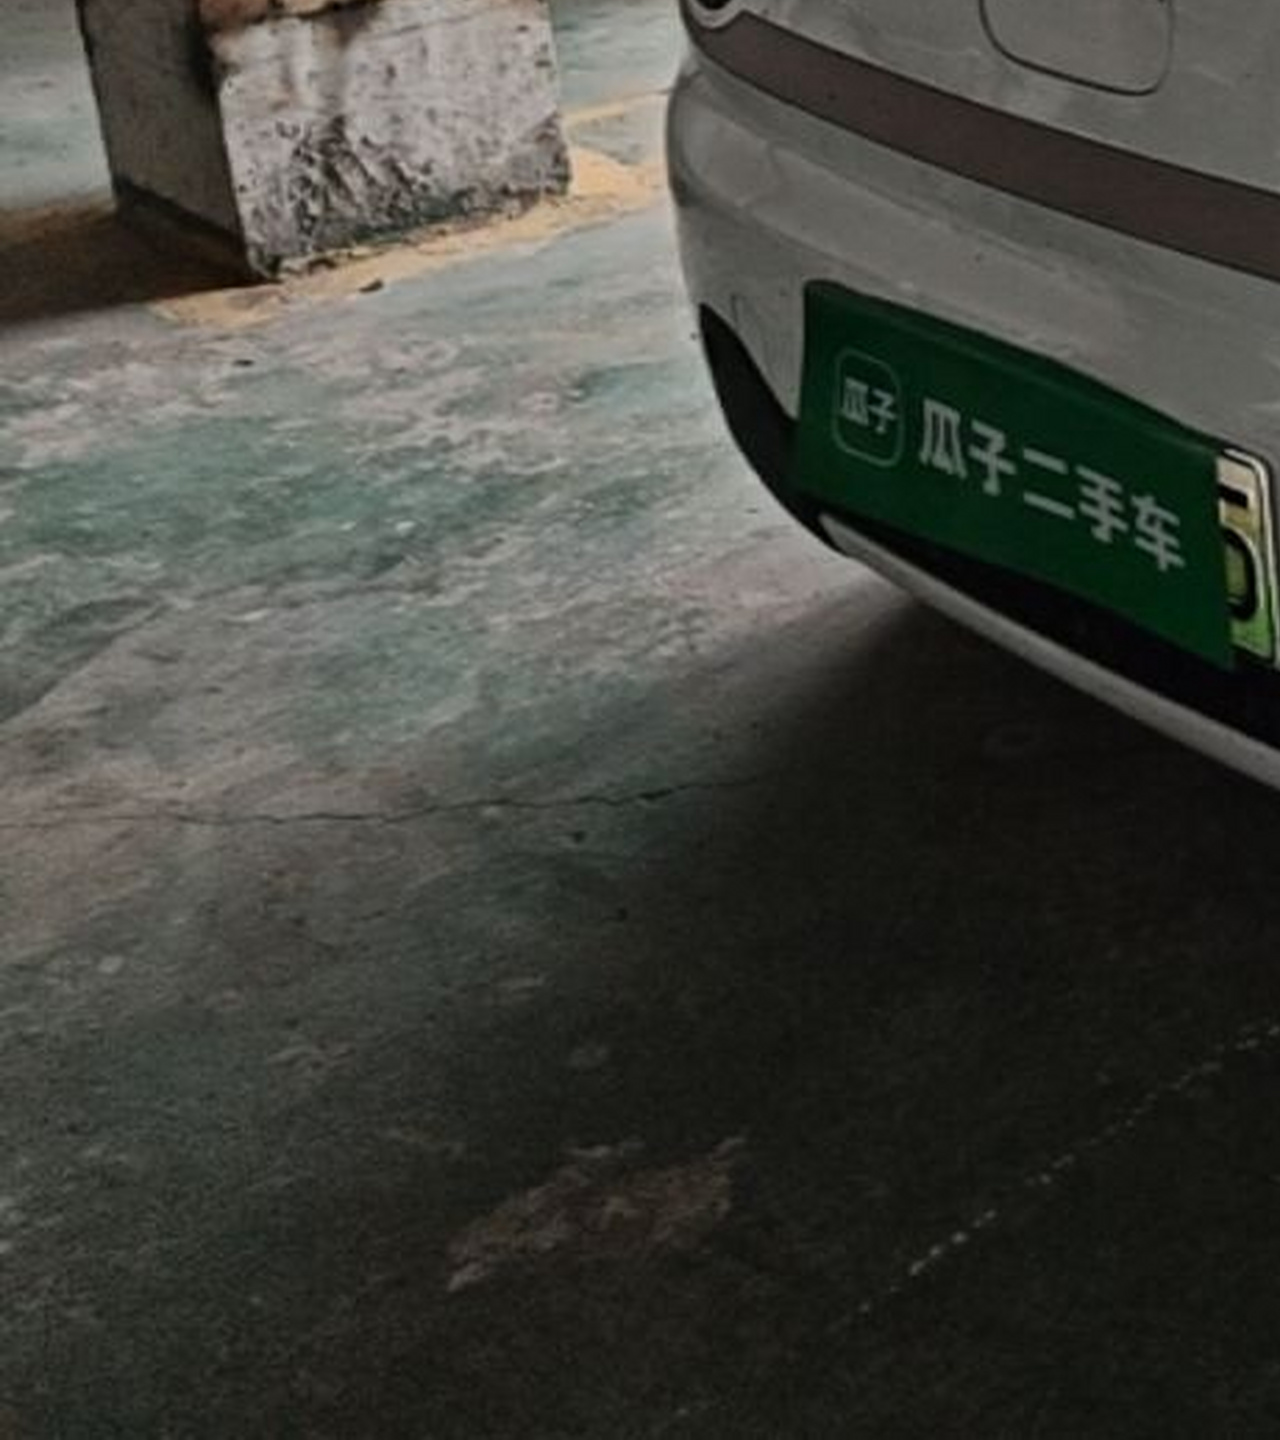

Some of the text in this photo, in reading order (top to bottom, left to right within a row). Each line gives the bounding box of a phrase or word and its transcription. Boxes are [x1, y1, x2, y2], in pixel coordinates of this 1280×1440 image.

[841, 376, 896, 434] 瓜子
[919, 397, 1185, 572] 瓜子二手车
